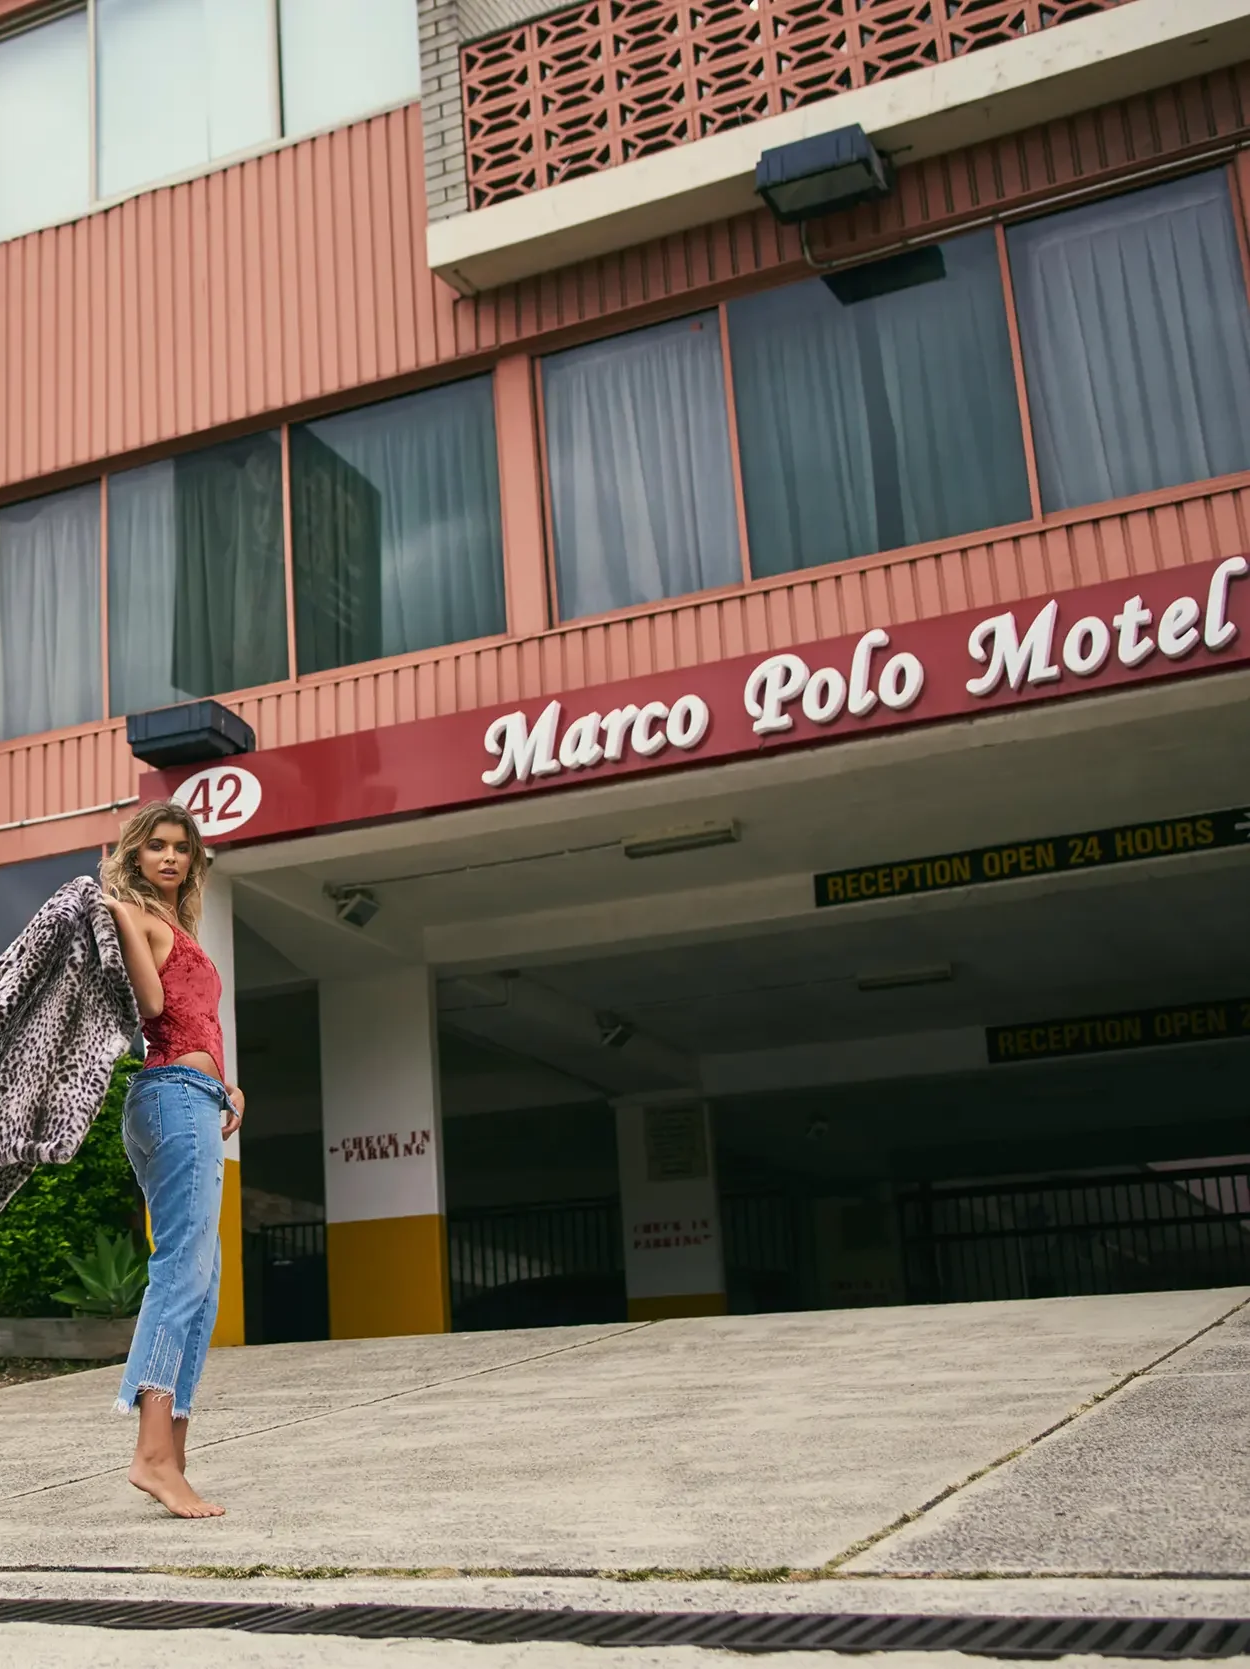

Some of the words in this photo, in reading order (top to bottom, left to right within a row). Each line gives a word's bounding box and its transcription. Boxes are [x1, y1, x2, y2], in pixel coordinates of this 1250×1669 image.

[481, 694, 710, 787] Marco
[744, 628, 925, 735] Polo
[966, 556, 1249, 697] Motel
[187, 773, 243, 823] 42
[827, 857, 972, 902] RECEPTION
[982, 844, 1055, 879] OPEN
[1068, 836, 1103, 865] 24
[1115, 819, 1215, 858] HOURS
[997, 1017, 1142, 1057] RECEPTION
[1154, 1006, 1227, 1038] OPEN
[341, 1133, 398, 1150] CHECK
[410, 1129, 431, 1144] IN
[344, 1142, 426, 1162] PARKING
